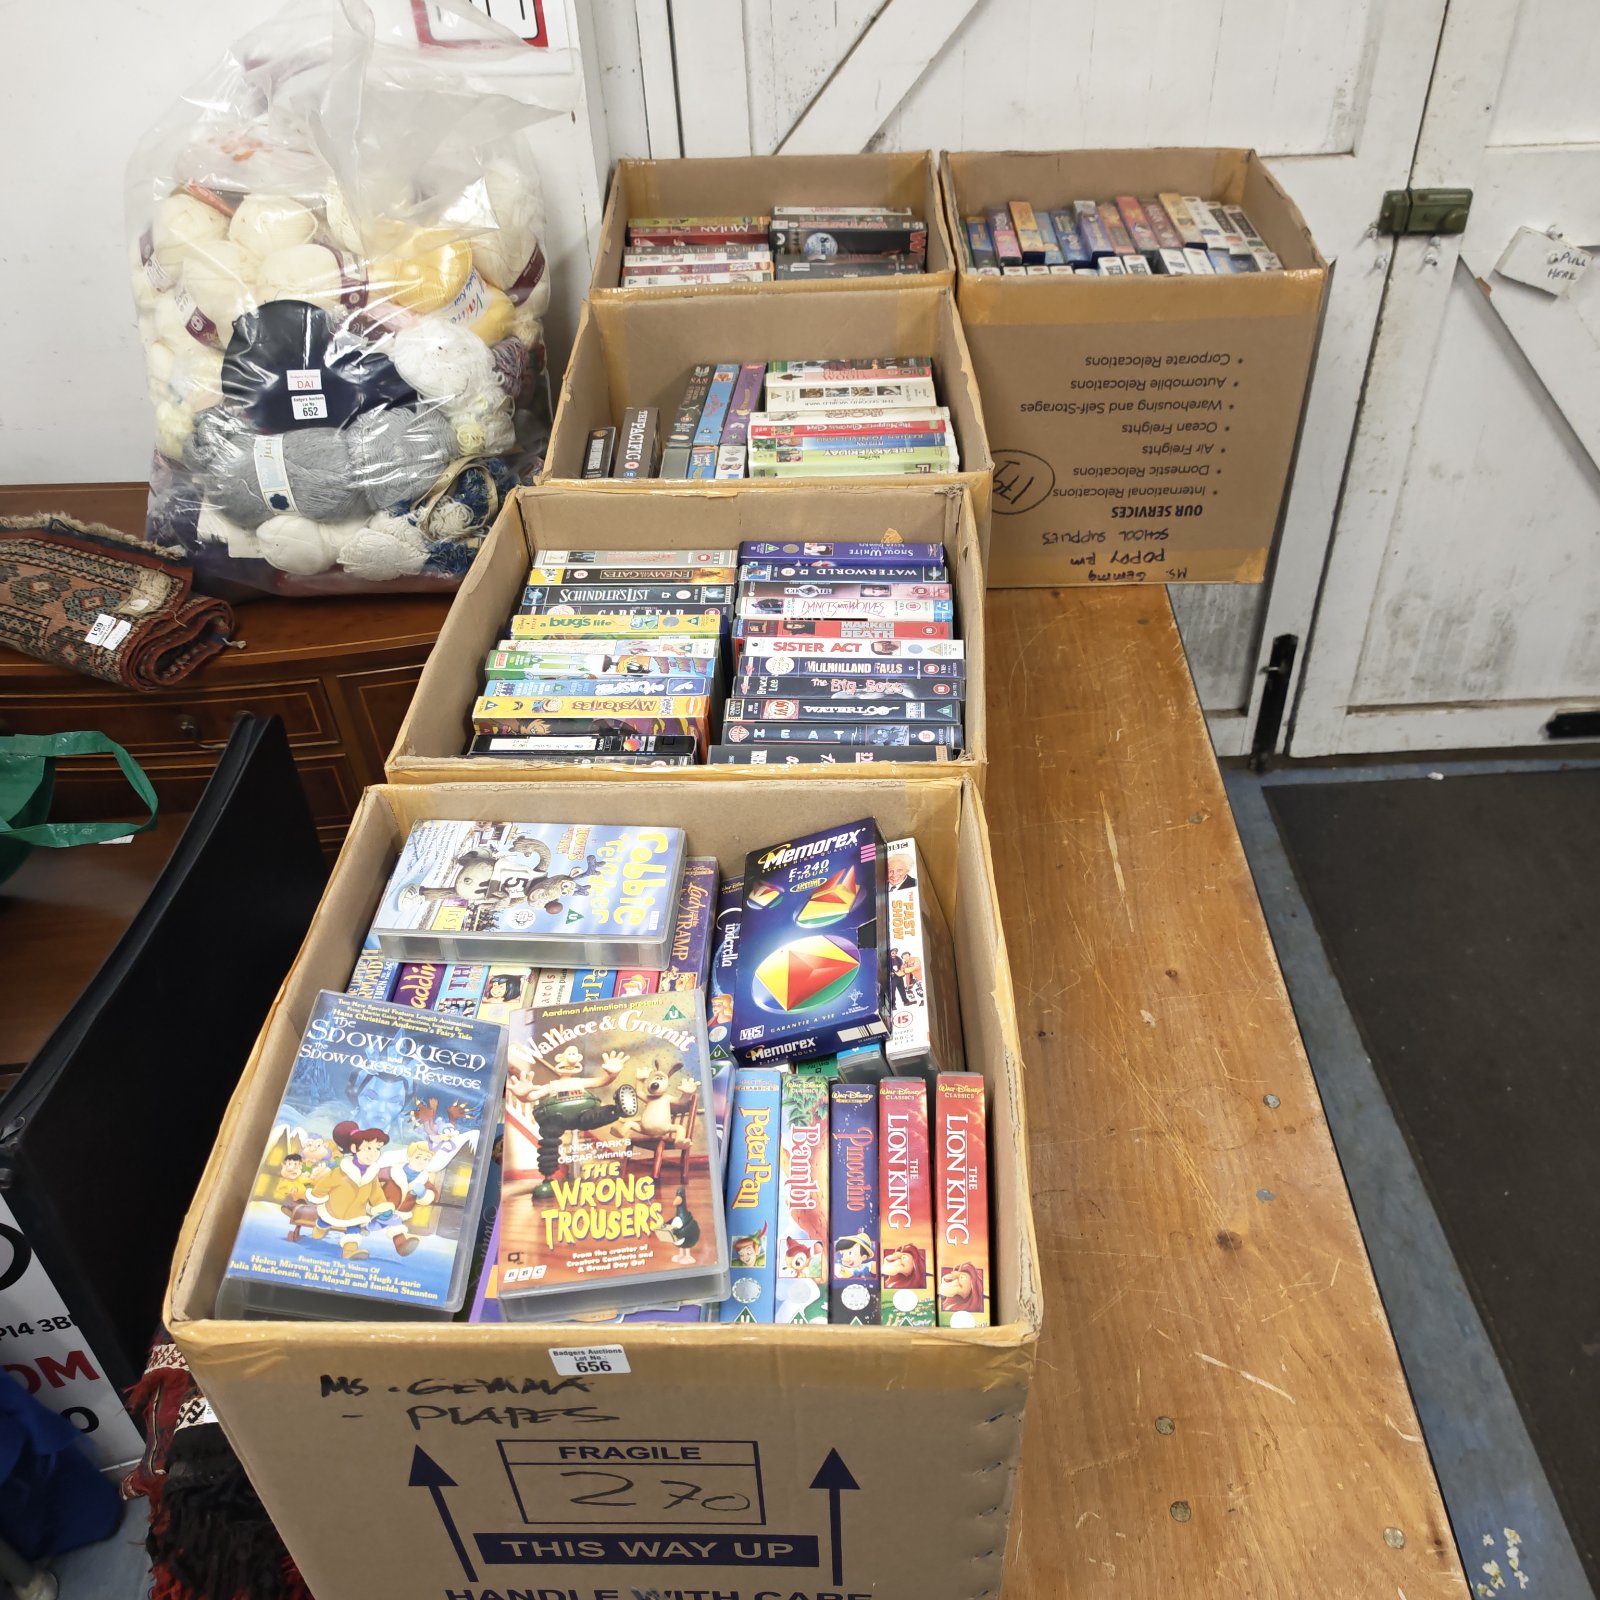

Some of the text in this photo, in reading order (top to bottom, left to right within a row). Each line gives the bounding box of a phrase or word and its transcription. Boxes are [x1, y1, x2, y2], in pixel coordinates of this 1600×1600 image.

[1085, 353, 1231, 368] Corporate Relocations
[1070, 376, 1227, 391] Automobile Relocations
[303, 406, 319, 417] 652
[1020, 400, 1223, 414] Warehousing and Self-Storages
[1121, 421, 1218, 434] Ocean Freights
[626, 422, 646, 461] PACIFIC
[1142, 443, 1214, 456] Air Freights
[1073, 464, 1210, 477] Domestic Relocations
[1052, 486, 1206, 498] International Relocations
[1111, 504, 1203, 518] OUR SERVICES
[1119, 527, 1169, 542] SCHOOL
[603, 570, 691, 579] ENEMY GATES
[816, 568, 917, 576] WATERWORLD
[626, 588, 650, 602] LIST
[549, 615, 592, 628] bug's
[593, 619, 612, 627] life
[841, 629, 892, 638] DEATH
[773, 641, 862, 653] SISTER ACT
[804, 661, 872, 674] MULHOLLAND
[874, 662, 903, 674] FALLS
[768, 679, 779, 692] Lee
[573, 699, 657, 712] Mysteries
[753, 728, 845, 740] HEAT
[763, 829, 861, 870] Memorex
[789, 859, 830, 879] E-240
[613, 832, 669, 925] robbie
[891, 899, 905, 941] SHOW
[903, 901, 916, 937] FAST
[674, 912, 692, 961] TRAMP
[367, 1004, 390, 1014] Special
[416, 1013, 438, 1023] Length
[542, 998, 664, 1018] Aardman Animations presents
[333, 1008, 473, 1041] Hans Christian Andersen's Fairy Tale
[770, 1020, 810, 1033] GARANTIE
[822, 1013, 835, 1021] VIE
[897, 1015, 909, 1024] 15
[515, 1009, 698, 1065] Wallace & Gromit
[740, 1025, 765, 1041] VHS
[751, 1036, 816, 1062] Memorex
[569, 1142, 594, 1152] NICK
[596, 1138, 632, 1149] PARK'S
[738, 1107, 771, 1169] Peter
[581, 1161, 621, 1180] THE
[784, 1122, 821, 1211] Bambi
[832, 1126, 874, 1212] Pinocchio
[887, 1112, 911, 1230] LION KING
[910, 1158, 919, 1180] THE
[732, 1163, 772, 1210] Pan
[946, 1113, 969, 1246] LION KING
[968, 1166, 978, 1191] THE
[550, 1173, 655, 1211] WRONG
[541, 1202, 665, 1250] TROUSERS
[298, 1255, 330, 1268] Featuring
[333, 1260, 346, 1269] The
[566, 1258, 600, 1268] Creature
[602, 1253, 637, 1264] Comforts
[572, 1252, 592, 1260] From
[251, 1255, 421, 1288] Helen Mirren, David Jason, Hugh Laurie
[504, 1264, 547, 1283] BBC
[586, 1263, 611, 1272] Grand
[612, 1261, 629, 1270] Day
[230, 1260, 249, 1271] Julia
[304, 1271, 319, 1282] Rik
[322, 1274, 350, 1287] Mayall
[352, 1278, 369, 1290] and
[370, 1281, 398, 1294] Imelda
[401, 1286, 438, 1300] Staunton
[576, 1360, 612, 1373] 656
[559, 1446, 702, 1460] FRAGILE
[501, 1540, 794, 1559] THIS WAY UP
